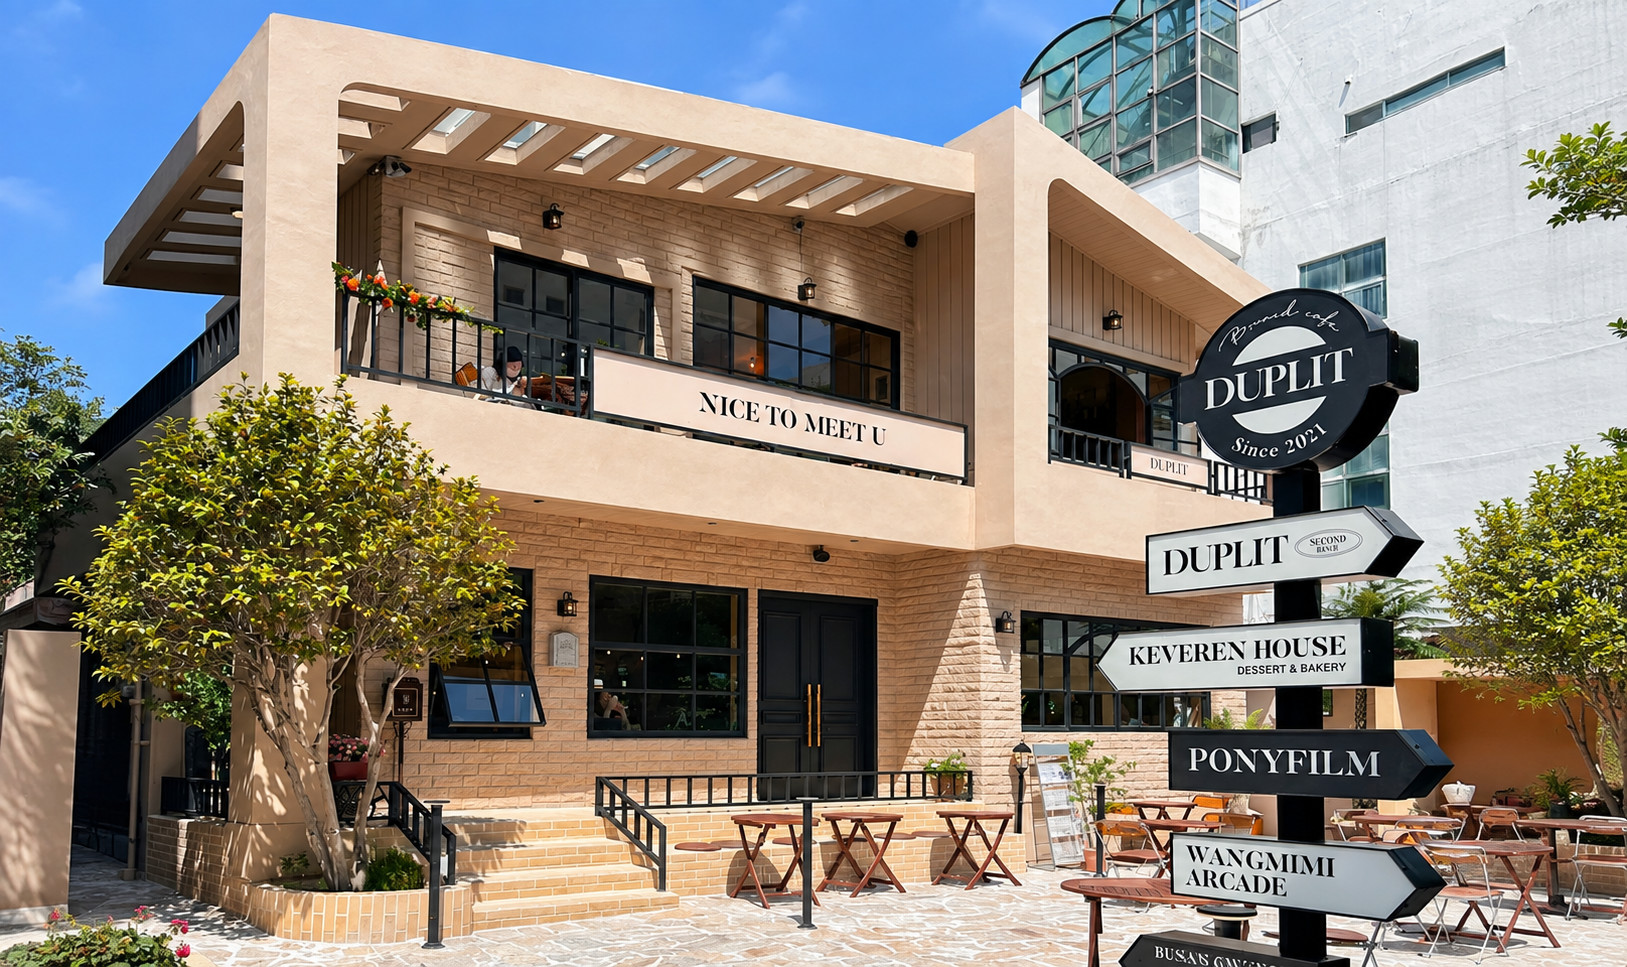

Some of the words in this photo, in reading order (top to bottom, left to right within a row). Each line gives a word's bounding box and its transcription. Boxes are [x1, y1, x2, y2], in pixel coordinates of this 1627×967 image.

[1204, 347, 1354, 411] DUPLIT
[699, 391, 760, 423] NICE
[765, 405, 797, 429] TO
[804, 413, 867, 443] MEET
[871, 427, 887, 446] U
[1231, 437, 1279, 458] Since
[1284, 423, 1328, 454] 2021
[1150, 457, 1189, 475] DUPLIT
[1163, 535, 1289, 576] DUPLIT
[1309, 534, 1347, 547] SECOND
[1128, 640, 1247, 666] KEVEREN
[1253, 635, 1347, 660] HOUSE
[1237, 664, 1287, 675] DESSERT
[1290, 663, 1298, 673] &
[1300, 662, 1347, 673] BAKERY
[1188, 747, 1381, 778] PONYFILM
[1185, 845, 1336, 878] WANGMIMI
[1185, 868, 1288, 898] ARCADE
